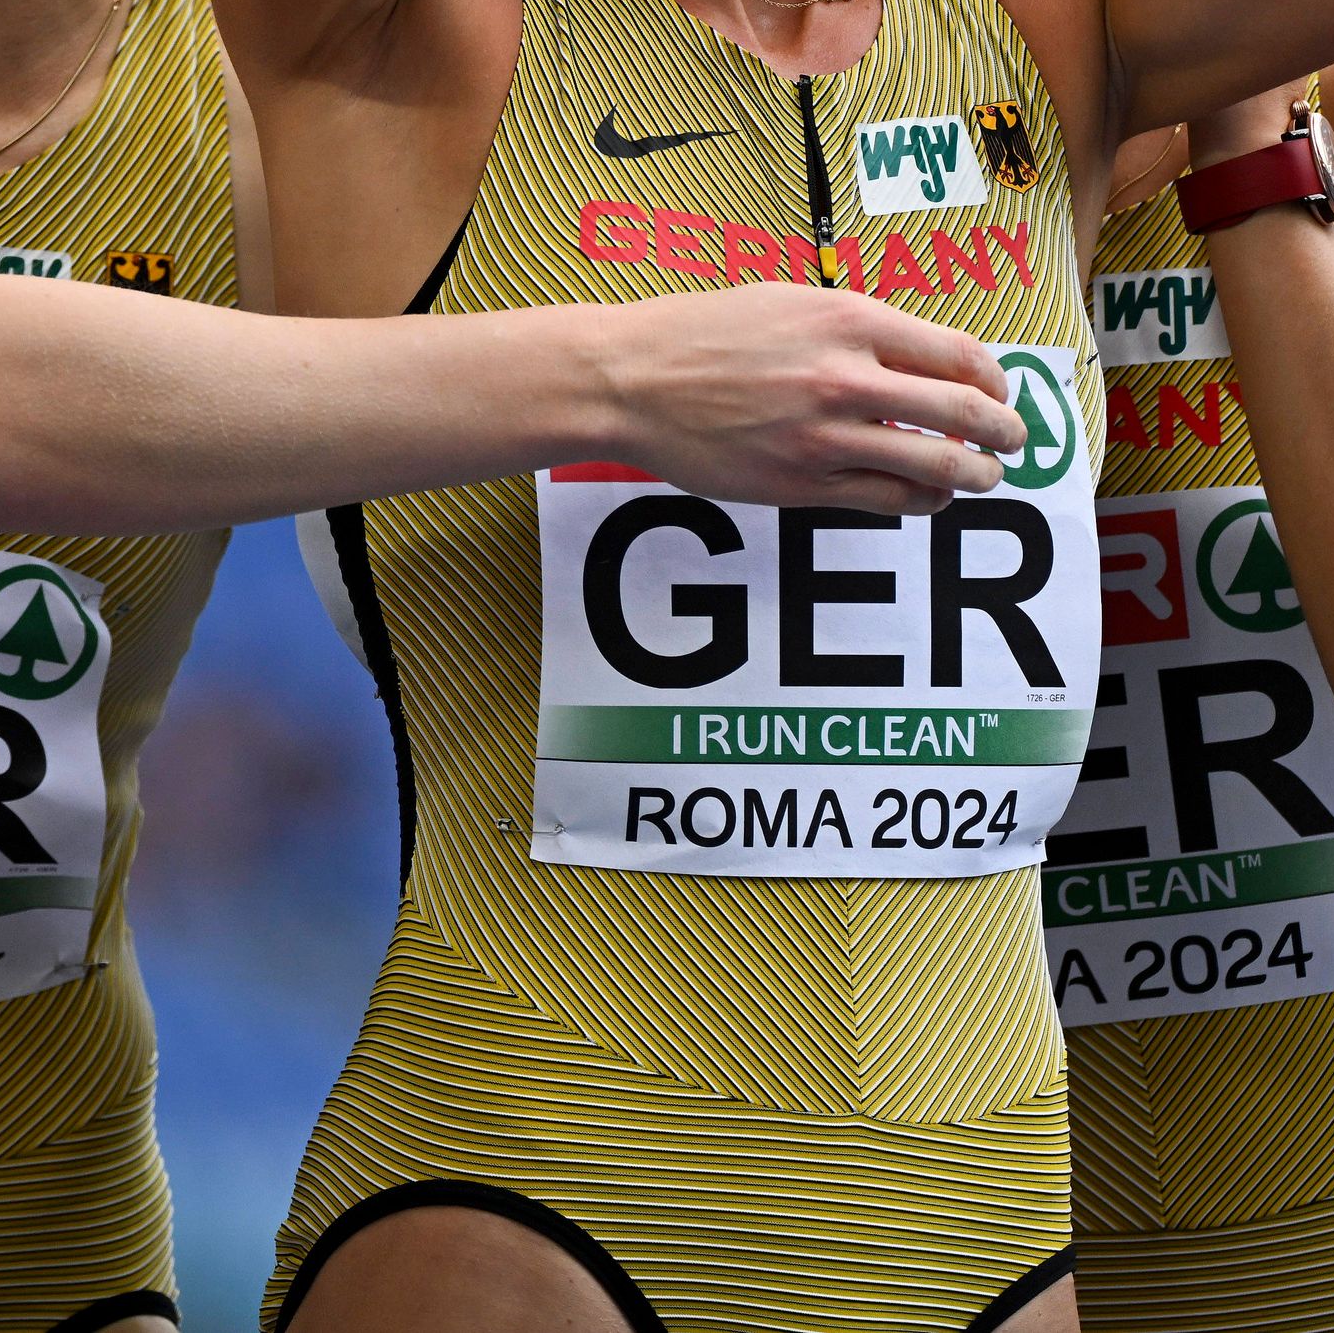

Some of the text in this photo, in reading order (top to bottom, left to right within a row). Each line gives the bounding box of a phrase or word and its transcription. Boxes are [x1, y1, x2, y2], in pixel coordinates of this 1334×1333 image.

[578, 199, 1035, 299] GERMANY
[583, 494, 1067, 689] GER
[1026, 693, 1044, 703] 1726
[1049, 693, 1066, 703] GER
[672, 714, 682, 757] I
[698, 714, 806, 757] RUN
[625, 785, 1019, 851] ROMA 2024
[1123, 921, 1315, 1002] 2024
